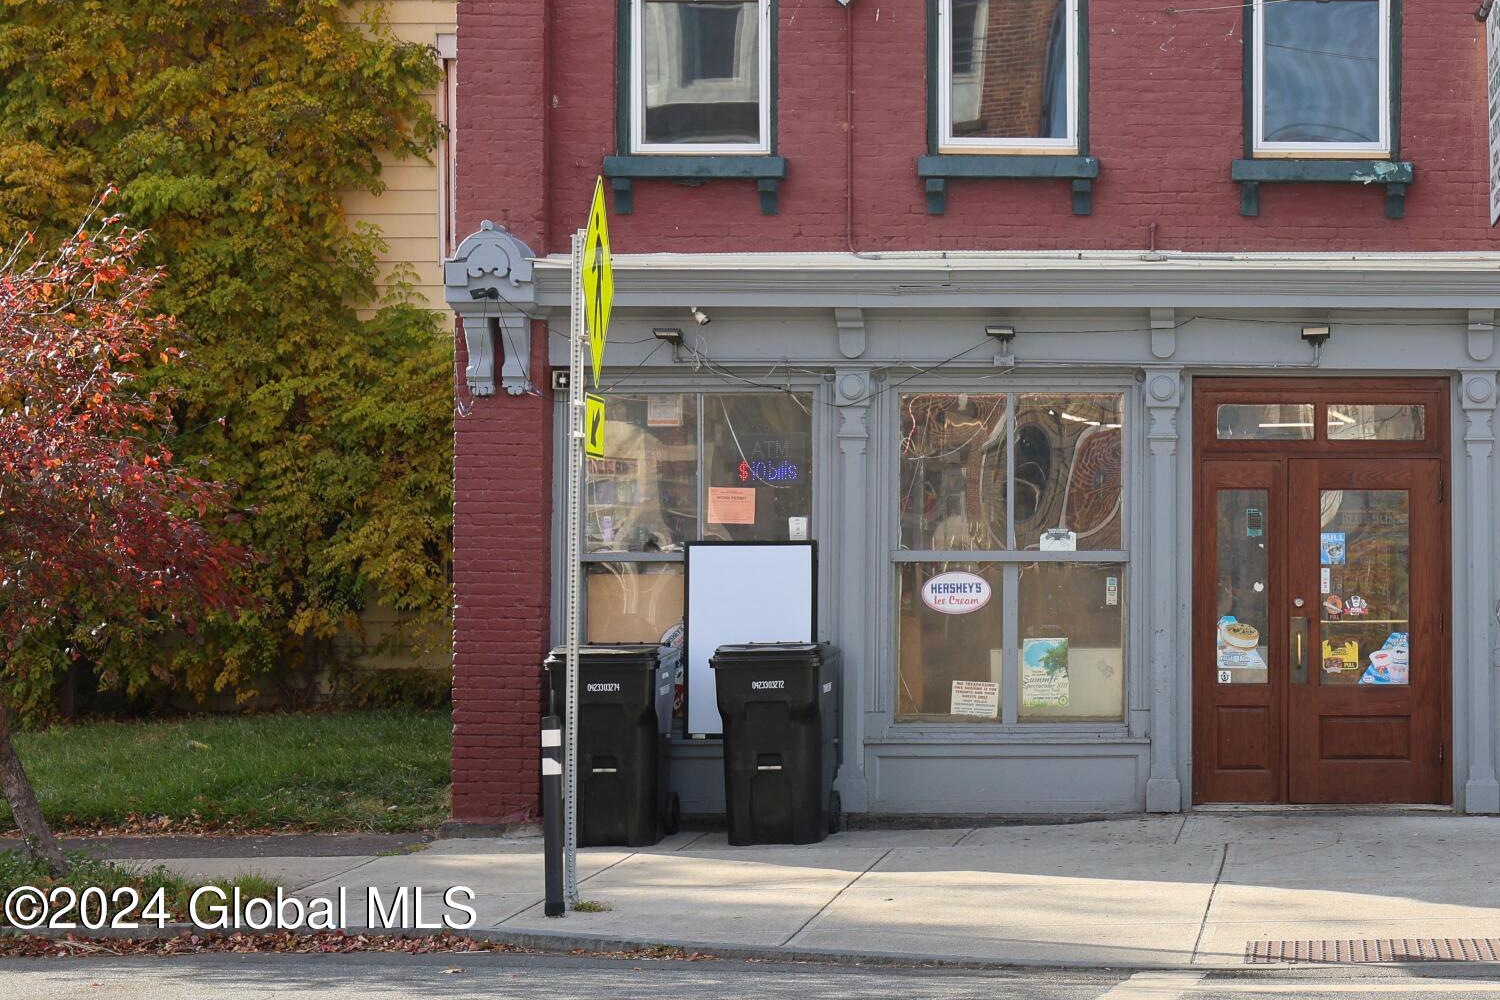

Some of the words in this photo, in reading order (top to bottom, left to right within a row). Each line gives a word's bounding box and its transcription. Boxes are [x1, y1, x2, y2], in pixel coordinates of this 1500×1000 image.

[752, 441, 792, 458] ATM
[931, 583, 982, 594] HERSHEY'S
[934, 596, 945, 605] Ice
[948, 596, 979, 605] Cream
[1024, 675, 1056, 684] Summer
[587, 683, 620, 692] 0423303274
[751, 680, 785, 690] 0423303272
